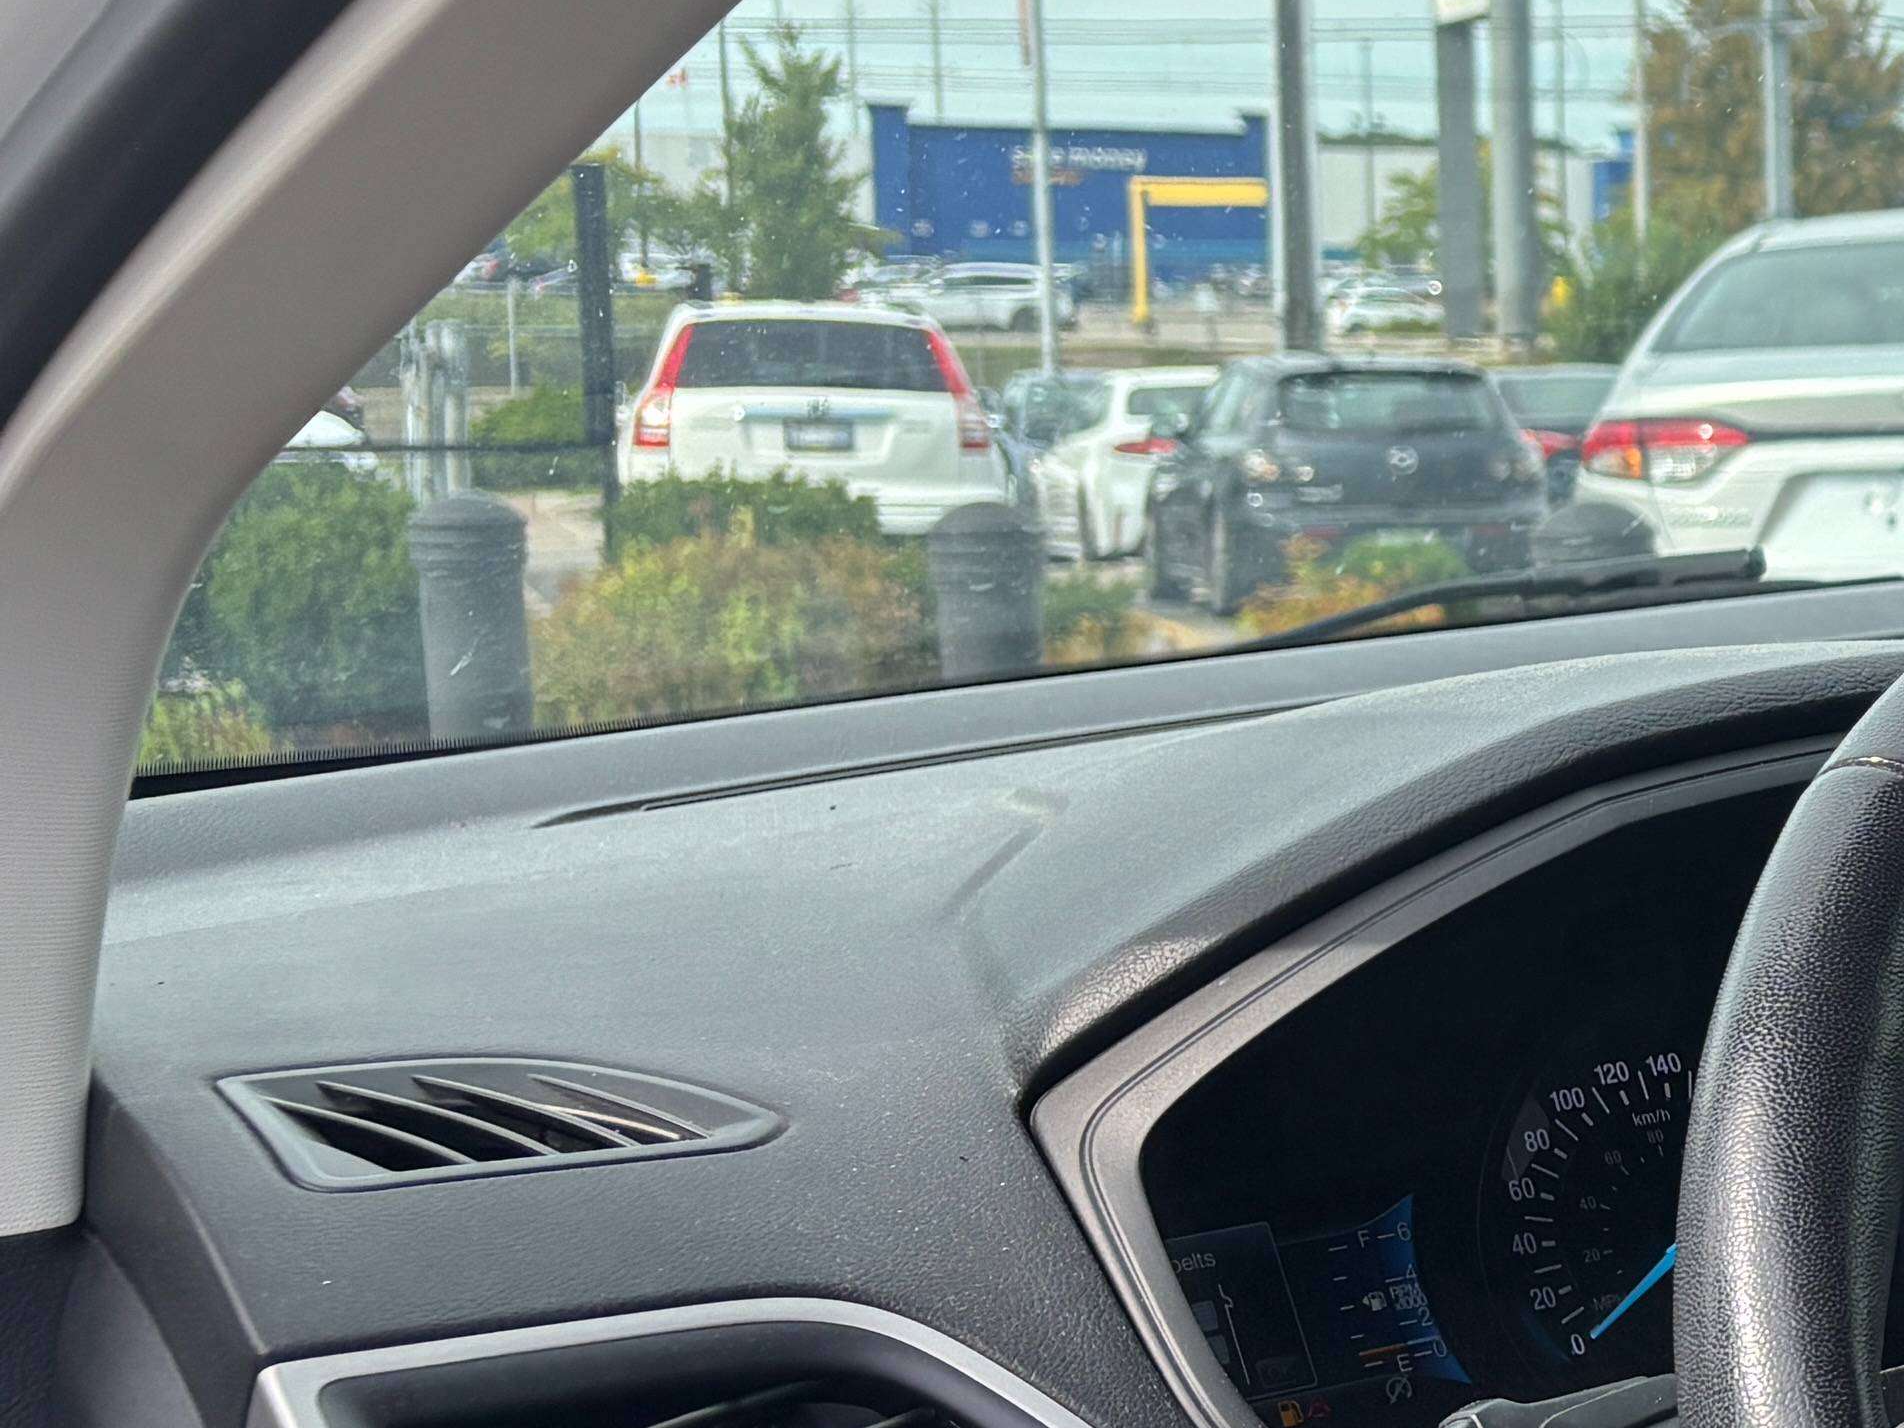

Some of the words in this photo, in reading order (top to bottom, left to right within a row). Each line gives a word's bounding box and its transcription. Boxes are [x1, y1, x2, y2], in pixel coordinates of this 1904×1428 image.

[1593, 1061, 1630, 1085] 120
[1646, 1052, 1682, 1077] 140
[1550, 1087, 1585, 1112] 100
[1631, 1108, 1671, 1126] km/h
[1524, 1128, 1550, 1152] 80
[1508, 1177, 1536, 1202] 60
[1357, 1229, 1371, 1249] F
[1397, 1222, 1412, 1242] 6
[1512, 1232, 1538, 1256] 40
[1529, 1286, 1557, 1311] 20
[1418, 1306, 1434, 1327] 2
[1432, 1336, 1448, 1358] 0
[1570, 1333, 1586, 1355] 0
[1396, 1353, 1414, 1373] E
